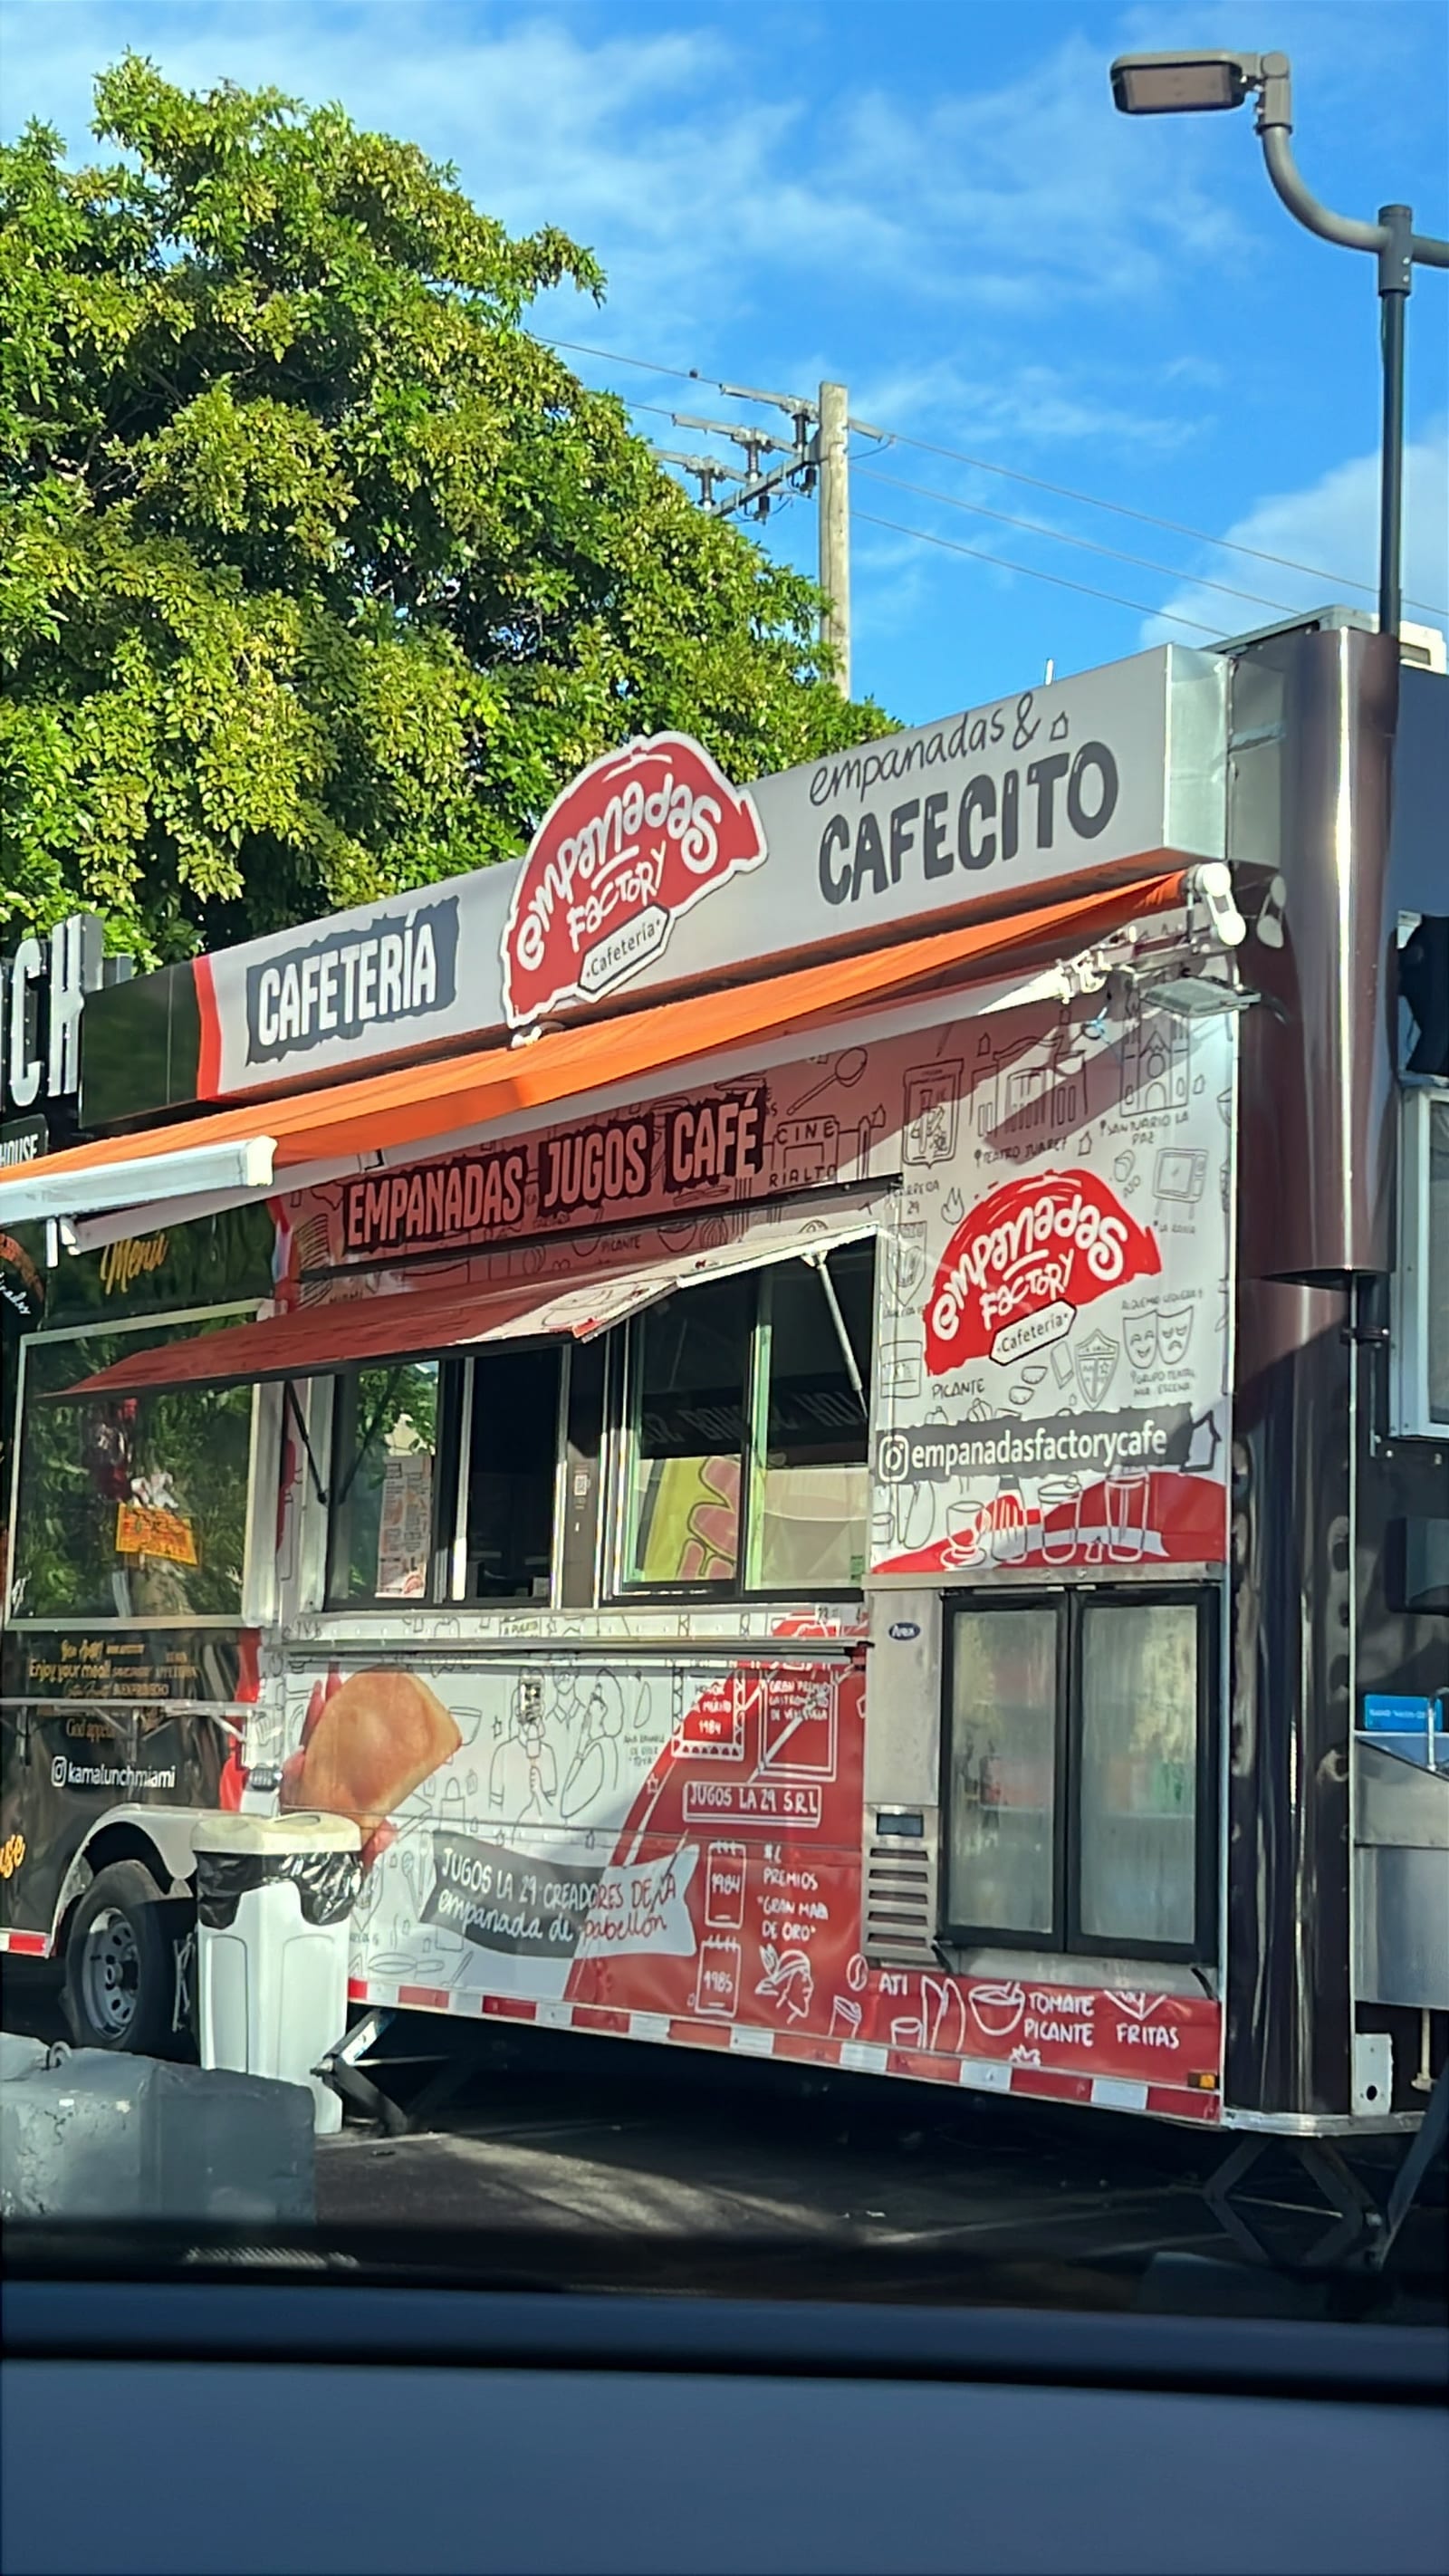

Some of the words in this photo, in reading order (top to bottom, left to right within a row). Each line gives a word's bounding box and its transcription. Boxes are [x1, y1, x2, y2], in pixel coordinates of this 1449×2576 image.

[810, 709, 1005, 806] empanadas
[1012, 692, 1039, 751] &
[819, 741, 1118, 905] CAFECITO
[515, 773, 722, 970] empanadas
[257, 910, 437, 1047] CAFETERÍA
[0, 913, 85, 1107] CH
[776, 1120, 835, 1145] CINE
[348, 1155, 525, 1246] EMPANADAS
[544, 1124, 648, 1208] JUGOS
[672, 1090, 759, 1183] CAFÉ
[770, 1164, 839, 1188] RIALTO
[932, 1194, 1129, 1341] empanadas
[932, 1378, 986, 1399] PICANTE
[911, 1419, 1167, 1475] empanadasfactorycafe
[68, 1763, 176, 1790] kamalunchmiami
[690, 1783, 733, 1806] JUGOS
[739, 1788, 756, 1810] LA
[760, 1789, 777, 1812] 29
[441, 1848, 493, 1894] JUGOS
[497, 1870, 513, 1902] LA
[519, 1874, 537, 1906] 29
[542, 1882, 624, 1912] CREADORES
[631, 1879, 651, 1909] DE
[710, 1873, 741, 1894] 1984
[763, 1867, 819, 1891] PREMIOS
[437, 1889, 543, 1943] empanada
[548, 1912, 574, 1942] de
[762, 1920, 778, 1941] DE
[1028, 1992, 1095, 2016] TOMATE
[1023, 2022, 1095, 2048] PICANTE
[1116, 2023, 1180, 2050] FRITAS
